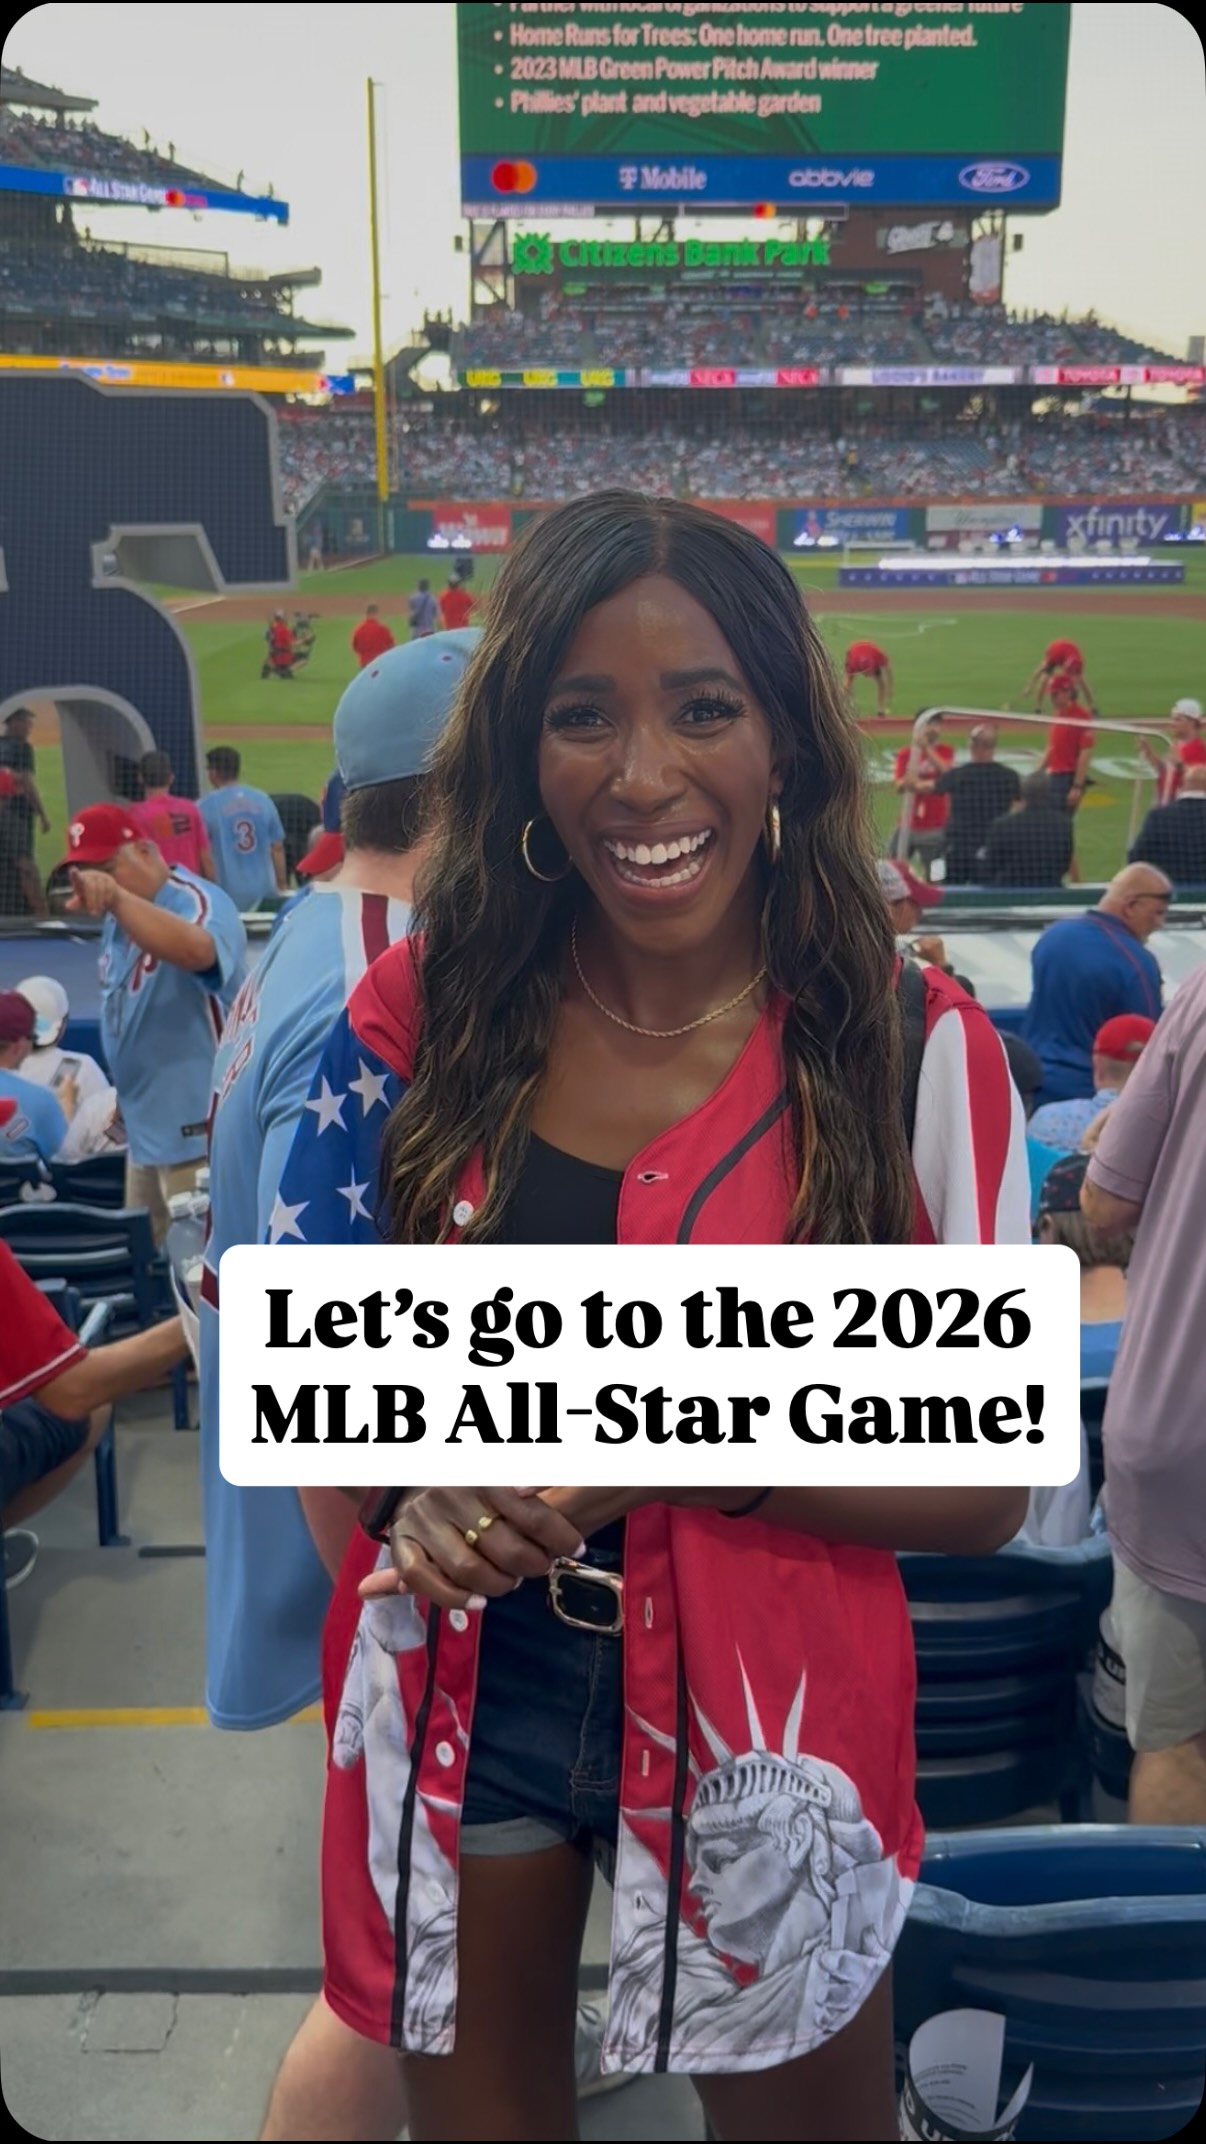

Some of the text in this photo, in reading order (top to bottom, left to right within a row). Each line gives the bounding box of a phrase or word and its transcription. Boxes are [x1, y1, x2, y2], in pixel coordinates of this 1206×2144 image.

[510, 23, 978, 50] Home Runs for Trees: One home run. One tree planted.
[511, 57, 879, 80] 2023 MLB Green Power Pitch Award winner
[581, 90, 627, 117] plant
[632, 90, 667, 113] and
[668, 90, 755, 117] vegetable
[757, 90, 821, 117] garden
[640, 166, 707, 190] Mobile
[788, 167, 875, 188] abbvie
[559, 237, 831, 268] Citizens Bank Park
[1066, 506, 1169, 541] xfinity
[233, 817, 257, 854] 3
